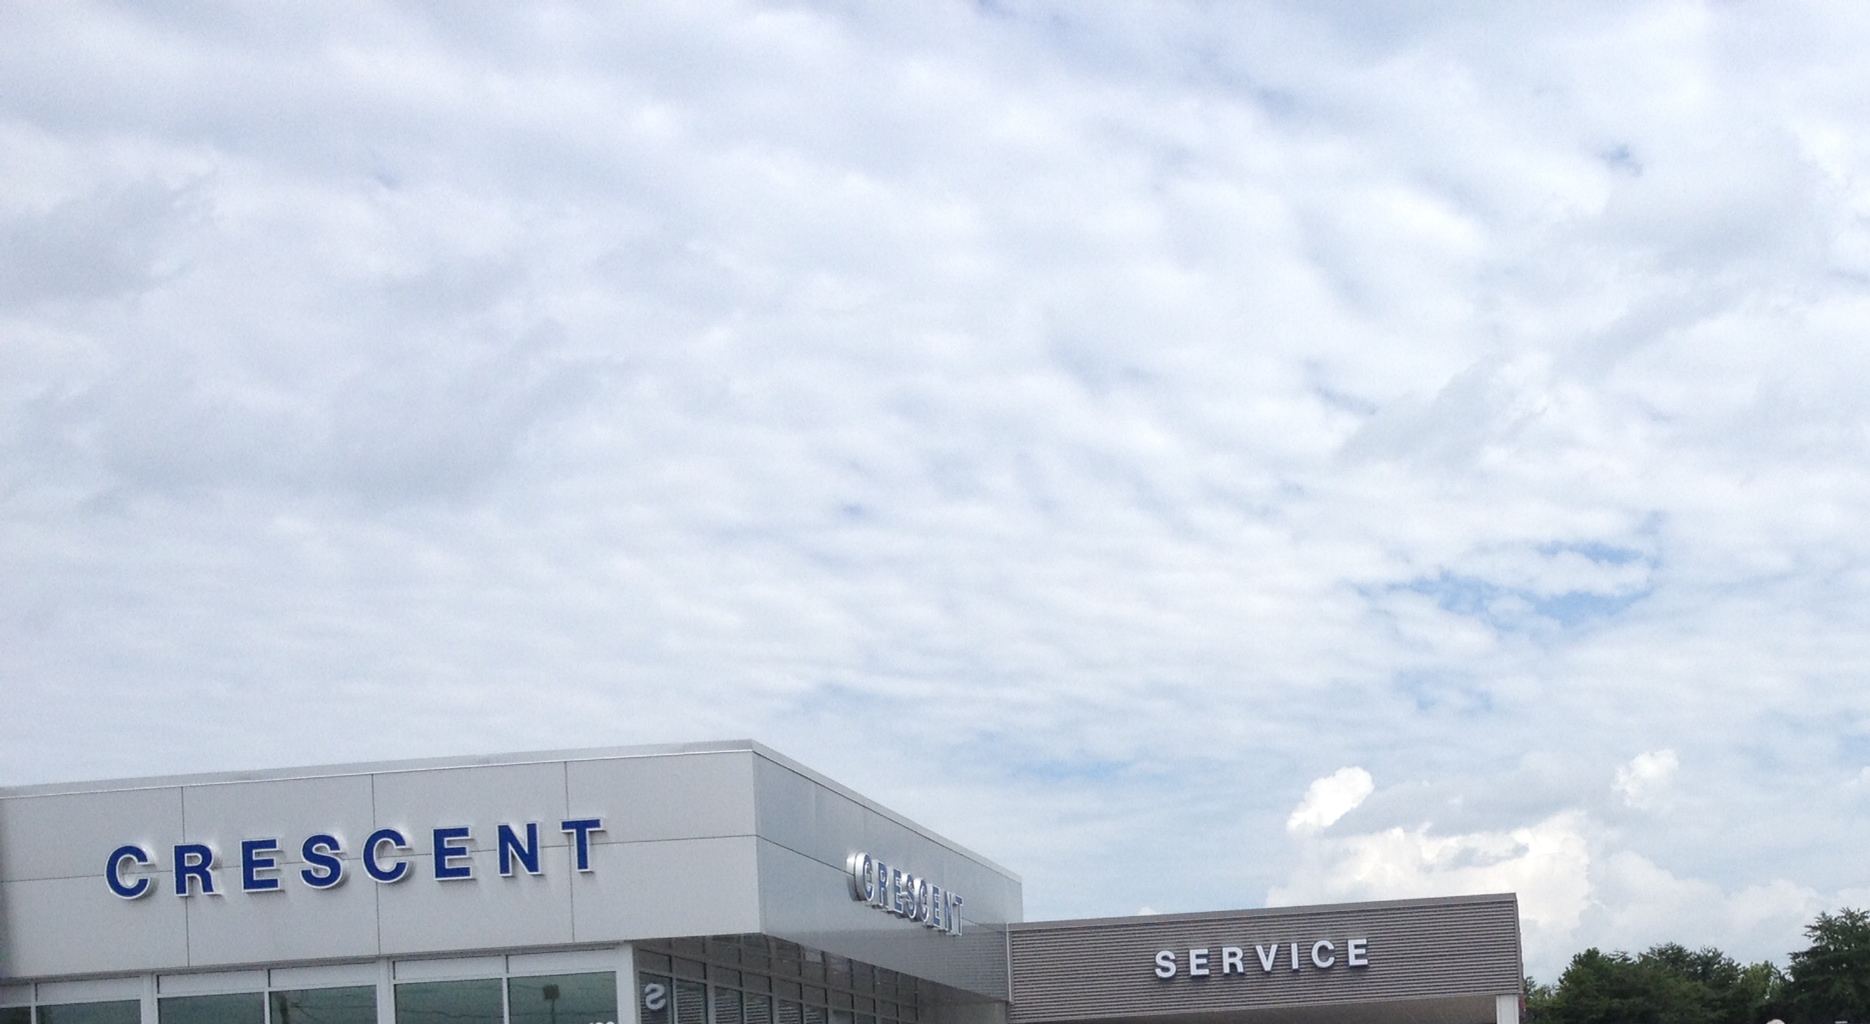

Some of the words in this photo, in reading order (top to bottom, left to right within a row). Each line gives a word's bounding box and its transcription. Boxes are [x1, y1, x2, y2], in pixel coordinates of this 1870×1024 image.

[105, 818, 606, 899] CRESCENT
[854, 852, 964, 935] CRESCENT
[1155, 938, 1369, 979] SERVICE
